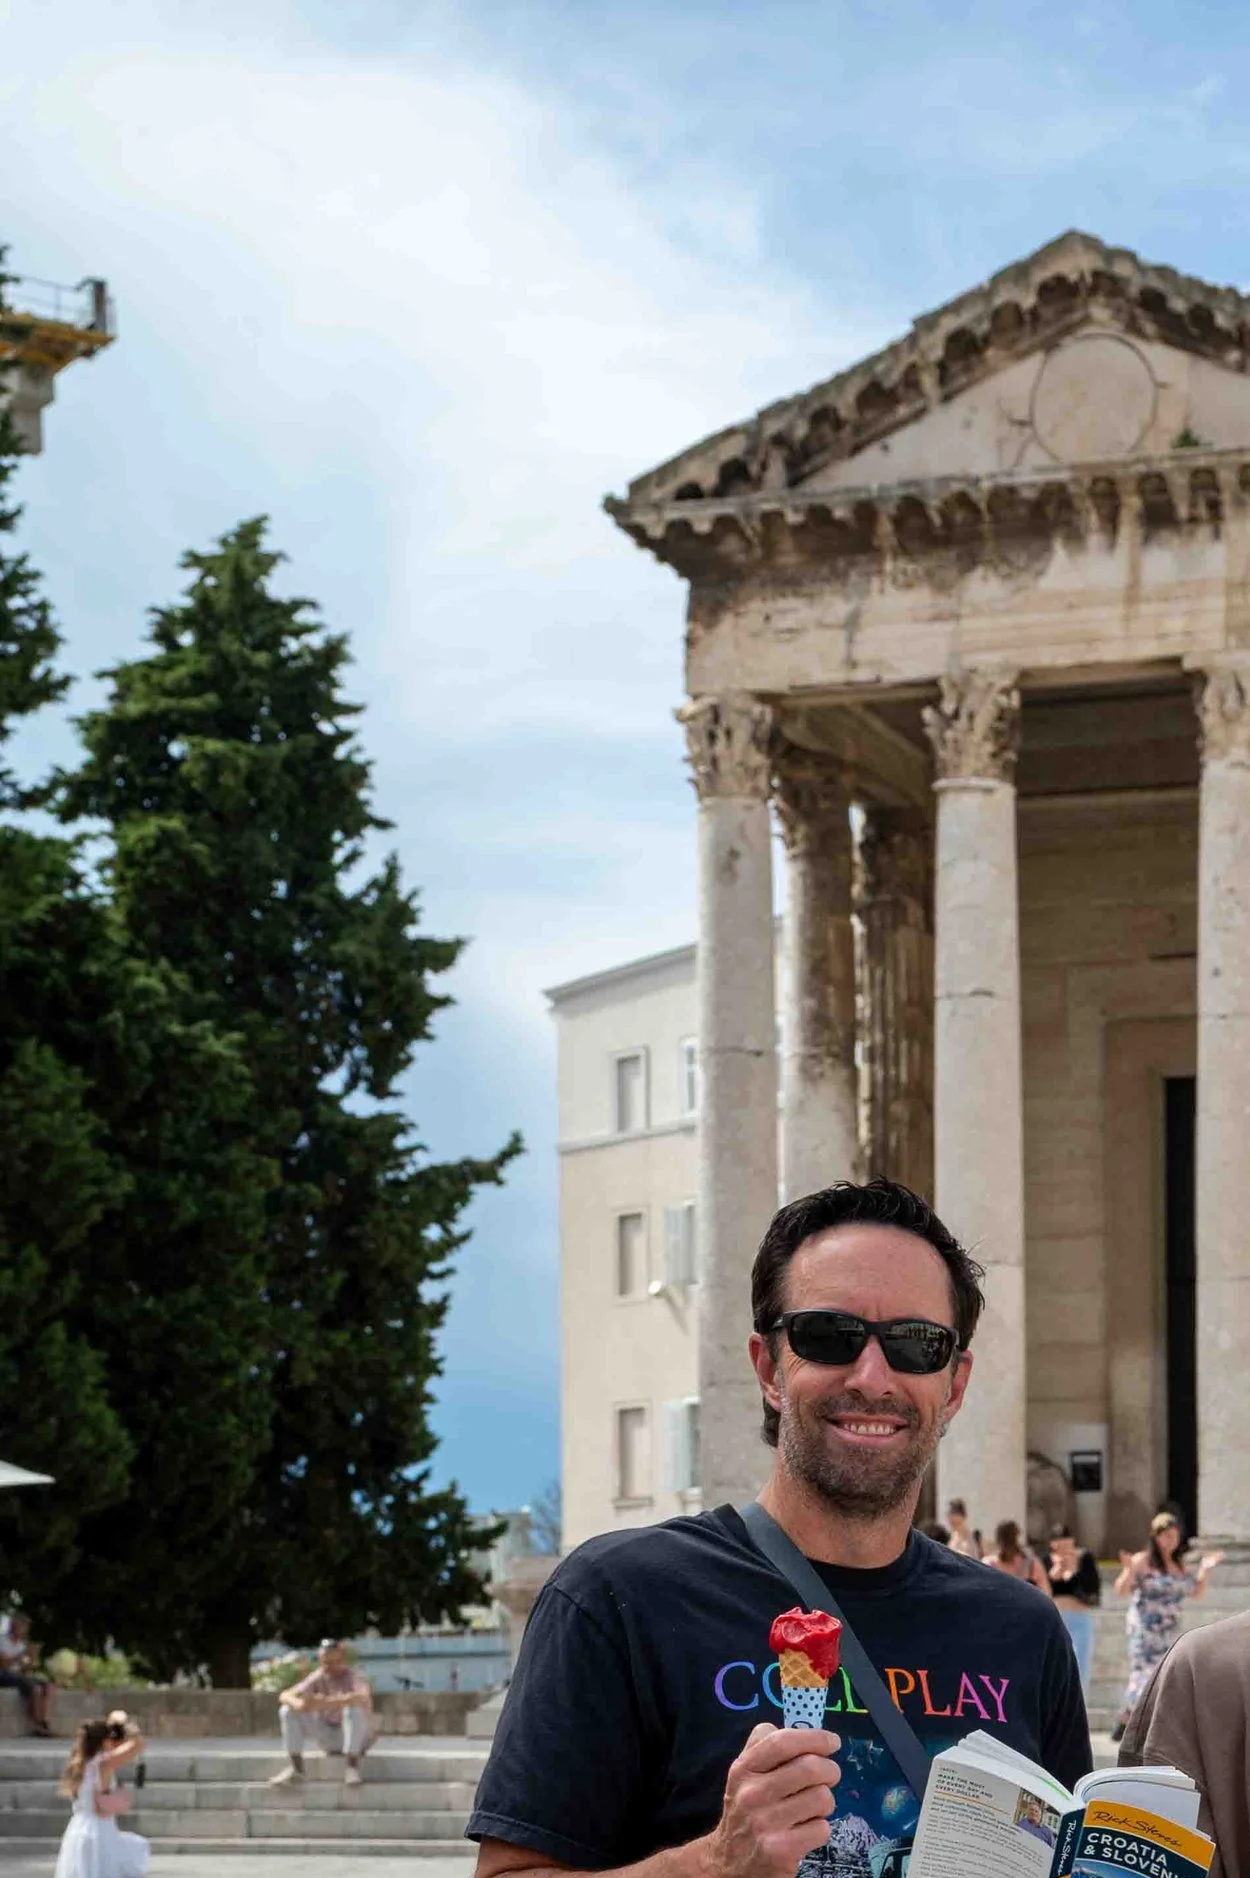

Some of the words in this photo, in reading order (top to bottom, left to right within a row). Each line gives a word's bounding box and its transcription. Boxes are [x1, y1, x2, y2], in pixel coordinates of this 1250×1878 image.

[714, 1661, 1009, 1723] CPLAY
[1083, 1844, 1095, 1856] &
[1087, 1832, 1168, 1867] CROATIA
